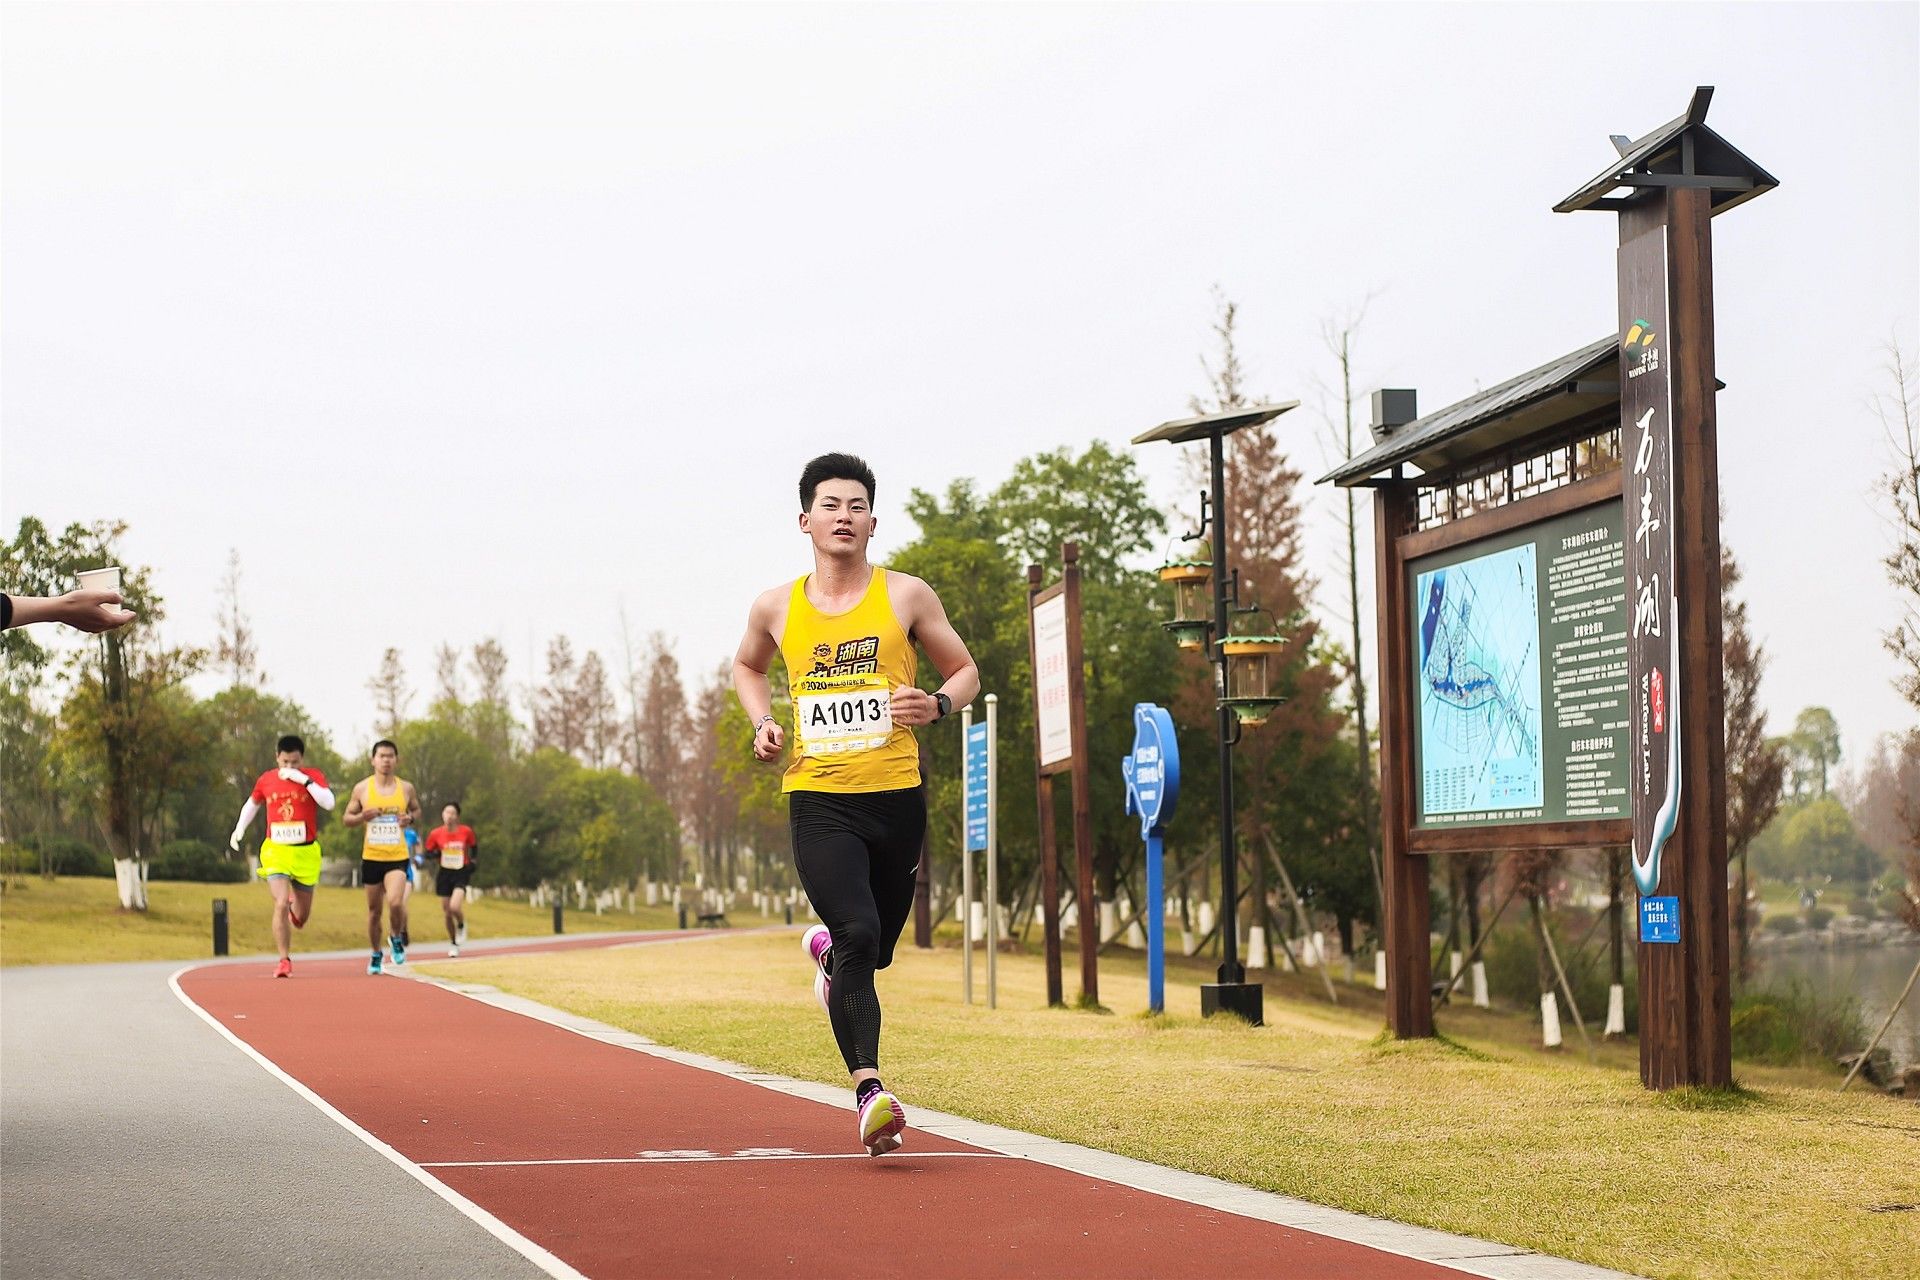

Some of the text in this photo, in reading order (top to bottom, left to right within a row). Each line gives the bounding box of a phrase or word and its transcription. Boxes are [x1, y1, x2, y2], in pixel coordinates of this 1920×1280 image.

[836, 637, 879, 663] 湖南
[806, 681, 827, 691] 2020
[812, 698, 881, 727] A1013
